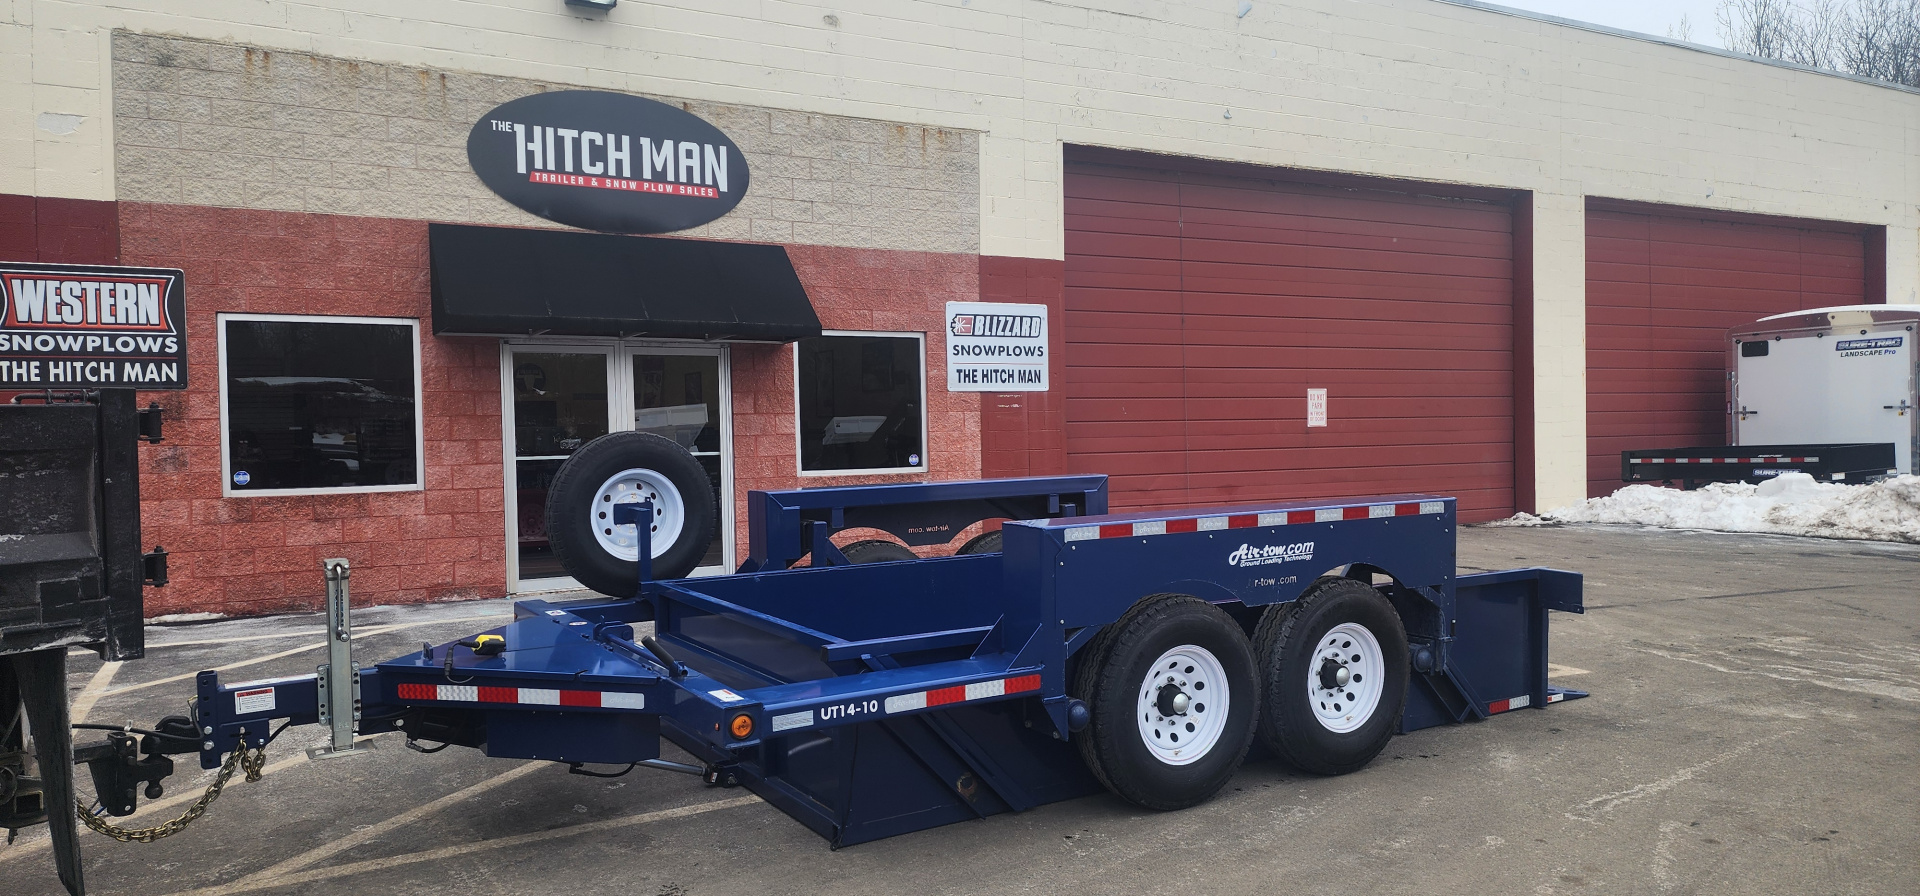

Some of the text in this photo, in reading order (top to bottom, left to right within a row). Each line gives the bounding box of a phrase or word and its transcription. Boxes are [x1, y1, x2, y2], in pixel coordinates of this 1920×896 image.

[491, 120, 728, 192] THE HITCH MAN
[534, 172, 713, 197] TRAILER & SNOW PLOW SALES
[11, 278, 161, 325] WESTERN
[974, 315, 1041, 337] BLIZZARD
[0, 335, 178, 353] SNOWPLOWS
[952, 344, 1044, 357] SNOWPLOWS
[1838, 338, 1901, 350] SURE-TRAC
[1840, 350, 1882, 358] LANDSCAPE
[0, 360, 178, 382] THE HITCH MAN
[956, 369, 1041, 383] THE HITCH MAN
[1229, 541, 1314, 565] Air-tow.com
[1240, 553, 1313, 568] Ground Loading Technology
[1247, 577, 1275, 587] r-tow
[820, 699, 878, 720] UT14-10
